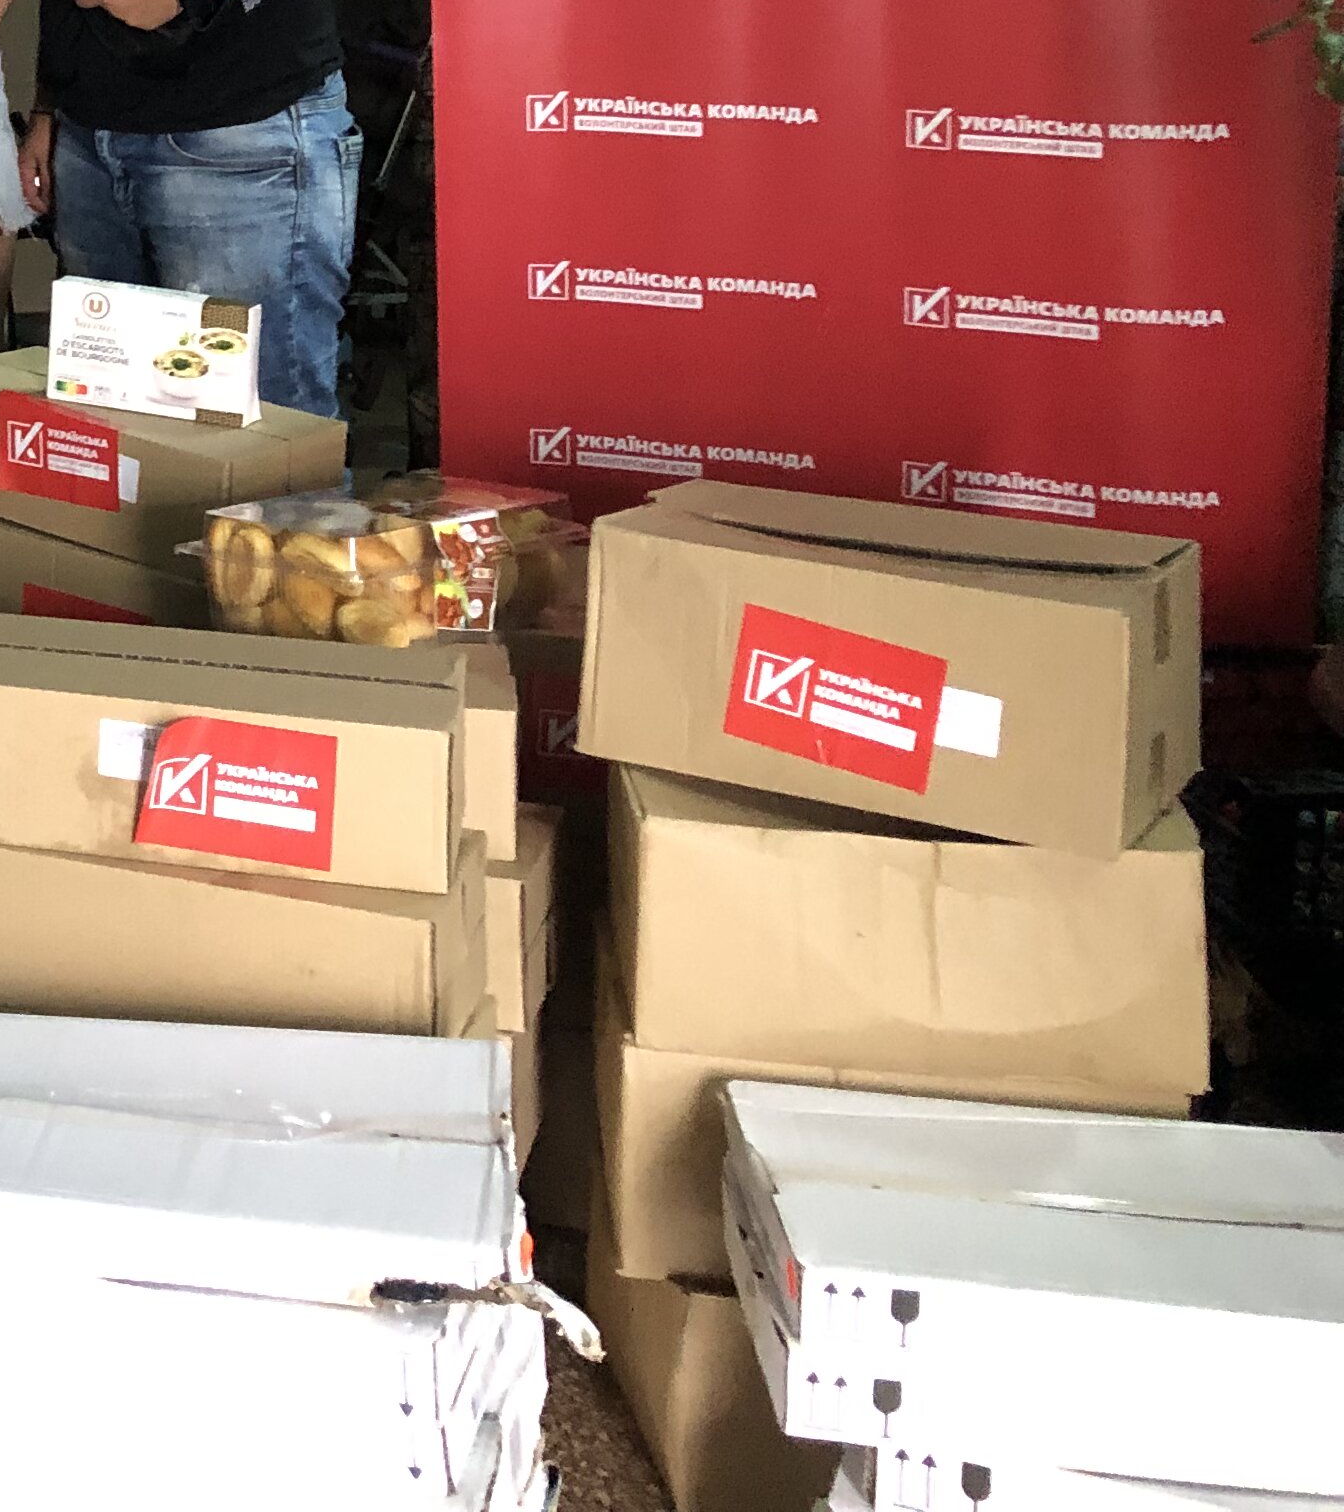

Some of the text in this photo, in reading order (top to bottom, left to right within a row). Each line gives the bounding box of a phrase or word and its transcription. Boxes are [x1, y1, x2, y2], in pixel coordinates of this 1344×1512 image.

[574, 97, 818, 124] УКРАЇНСЬКА КОМАНДА
[958, 115, 1230, 142] УКРАЇНСЬКА КОМАНДА
[575, 267, 816, 299] УКРАЇНСЬКА КОМАНДА
[956, 295, 1225, 327] УКРАЇНСЬКА КОМАНДА
[576, 434, 816, 469] УКРАЇНСЬКА КОМАНДА
[953, 470, 1220, 508] УКРАЇНСЬКА КОМАНДА
[814, 685, 900, 720] КОМАНДА
[818, 668, 922, 709] УКРАЇНСЬКА
[215, 779, 299, 804] КОМАНДА
[216, 762, 319, 789] УКРАЇНСЬКА
